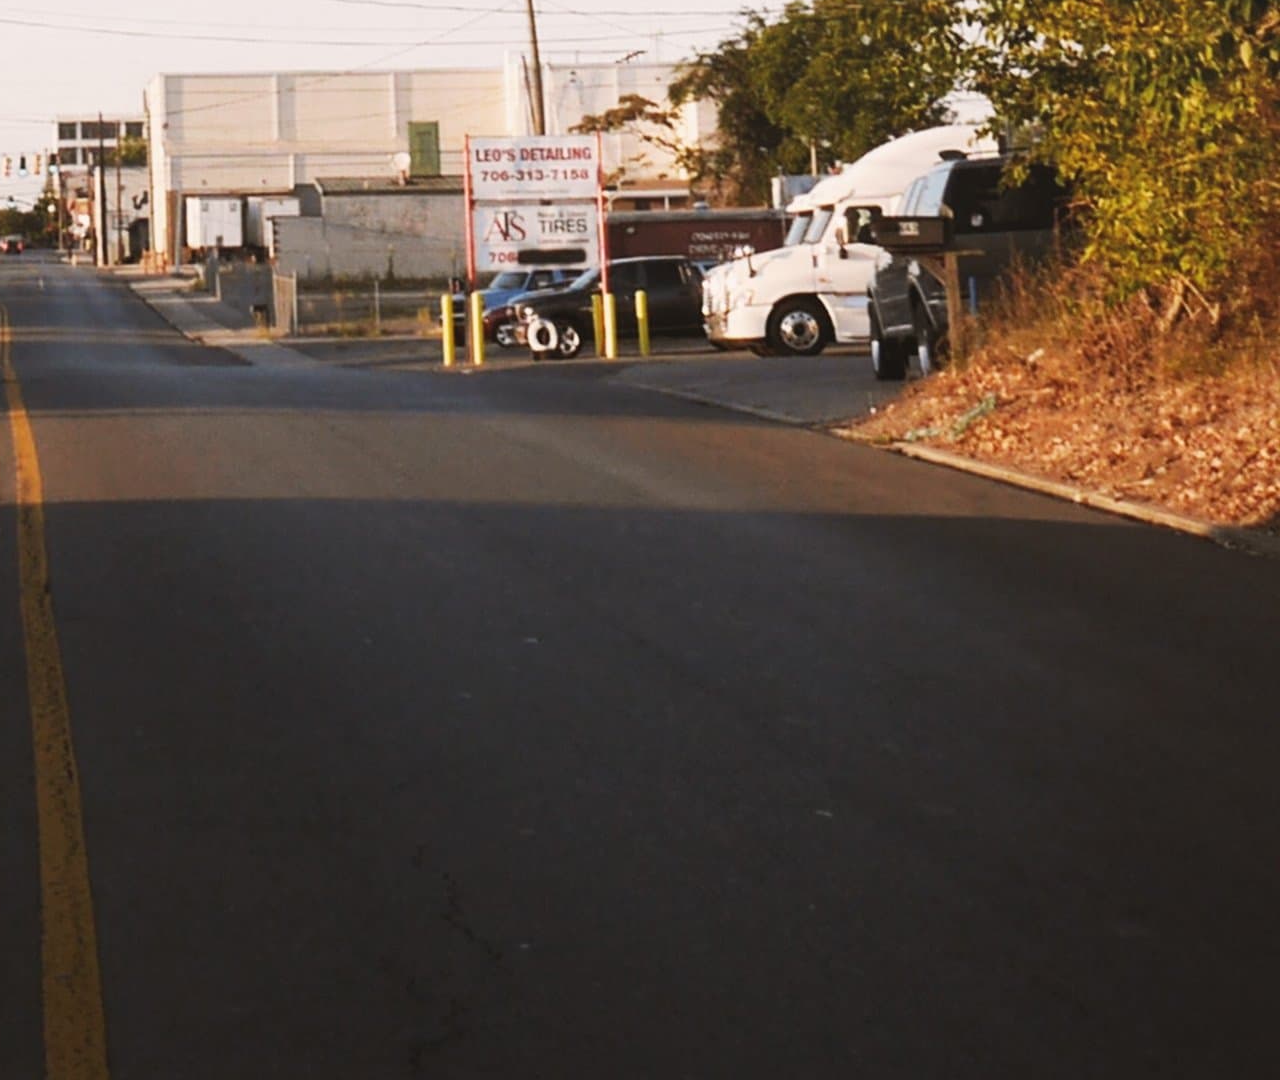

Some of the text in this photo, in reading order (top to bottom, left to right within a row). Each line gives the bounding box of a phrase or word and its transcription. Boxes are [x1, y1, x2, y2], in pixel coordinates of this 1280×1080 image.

[475, 146, 592, 162] LEO'S DETAILING
[539, 218, 588, 233] TIRES
